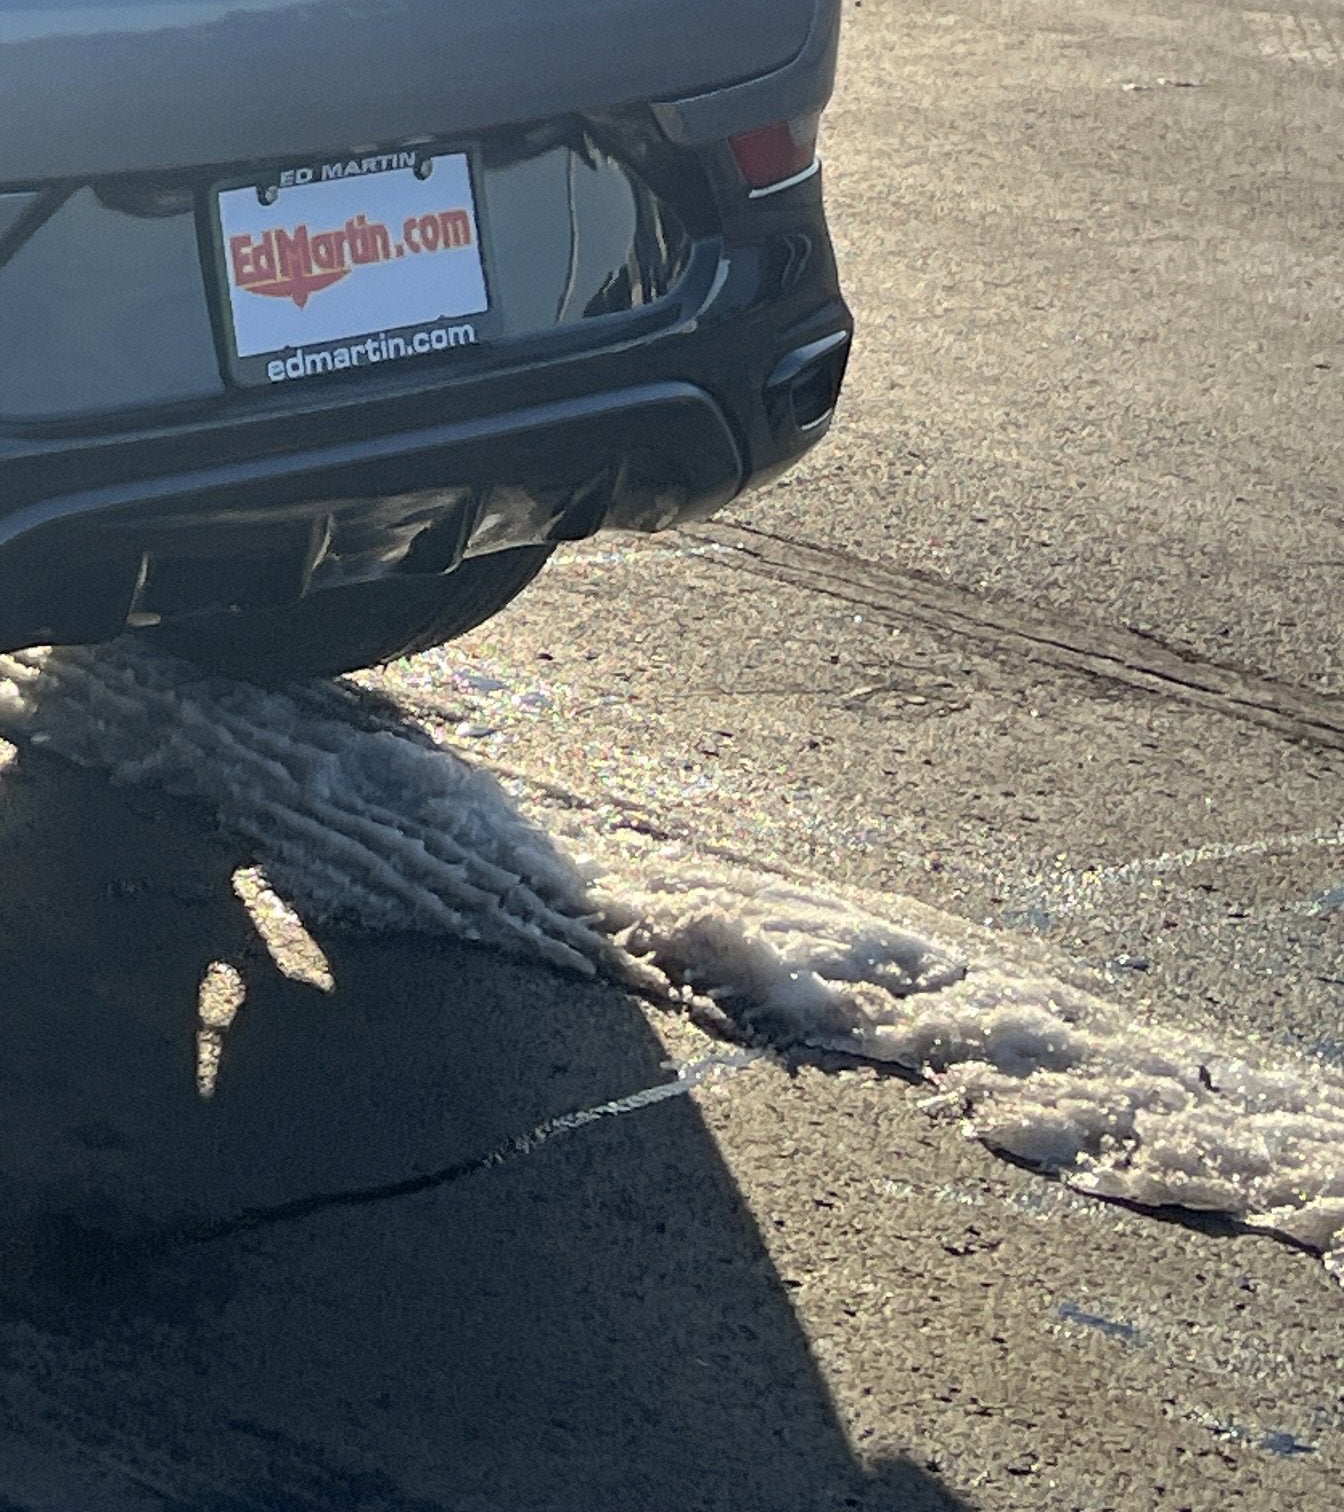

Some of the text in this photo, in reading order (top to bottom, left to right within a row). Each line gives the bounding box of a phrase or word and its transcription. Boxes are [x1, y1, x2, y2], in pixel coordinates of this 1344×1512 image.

[280, 151, 417, 187] ED MARTIN
[230, 208, 472, 287] EdMartin.com
[267, 324, 475, 382] edmartin.com
